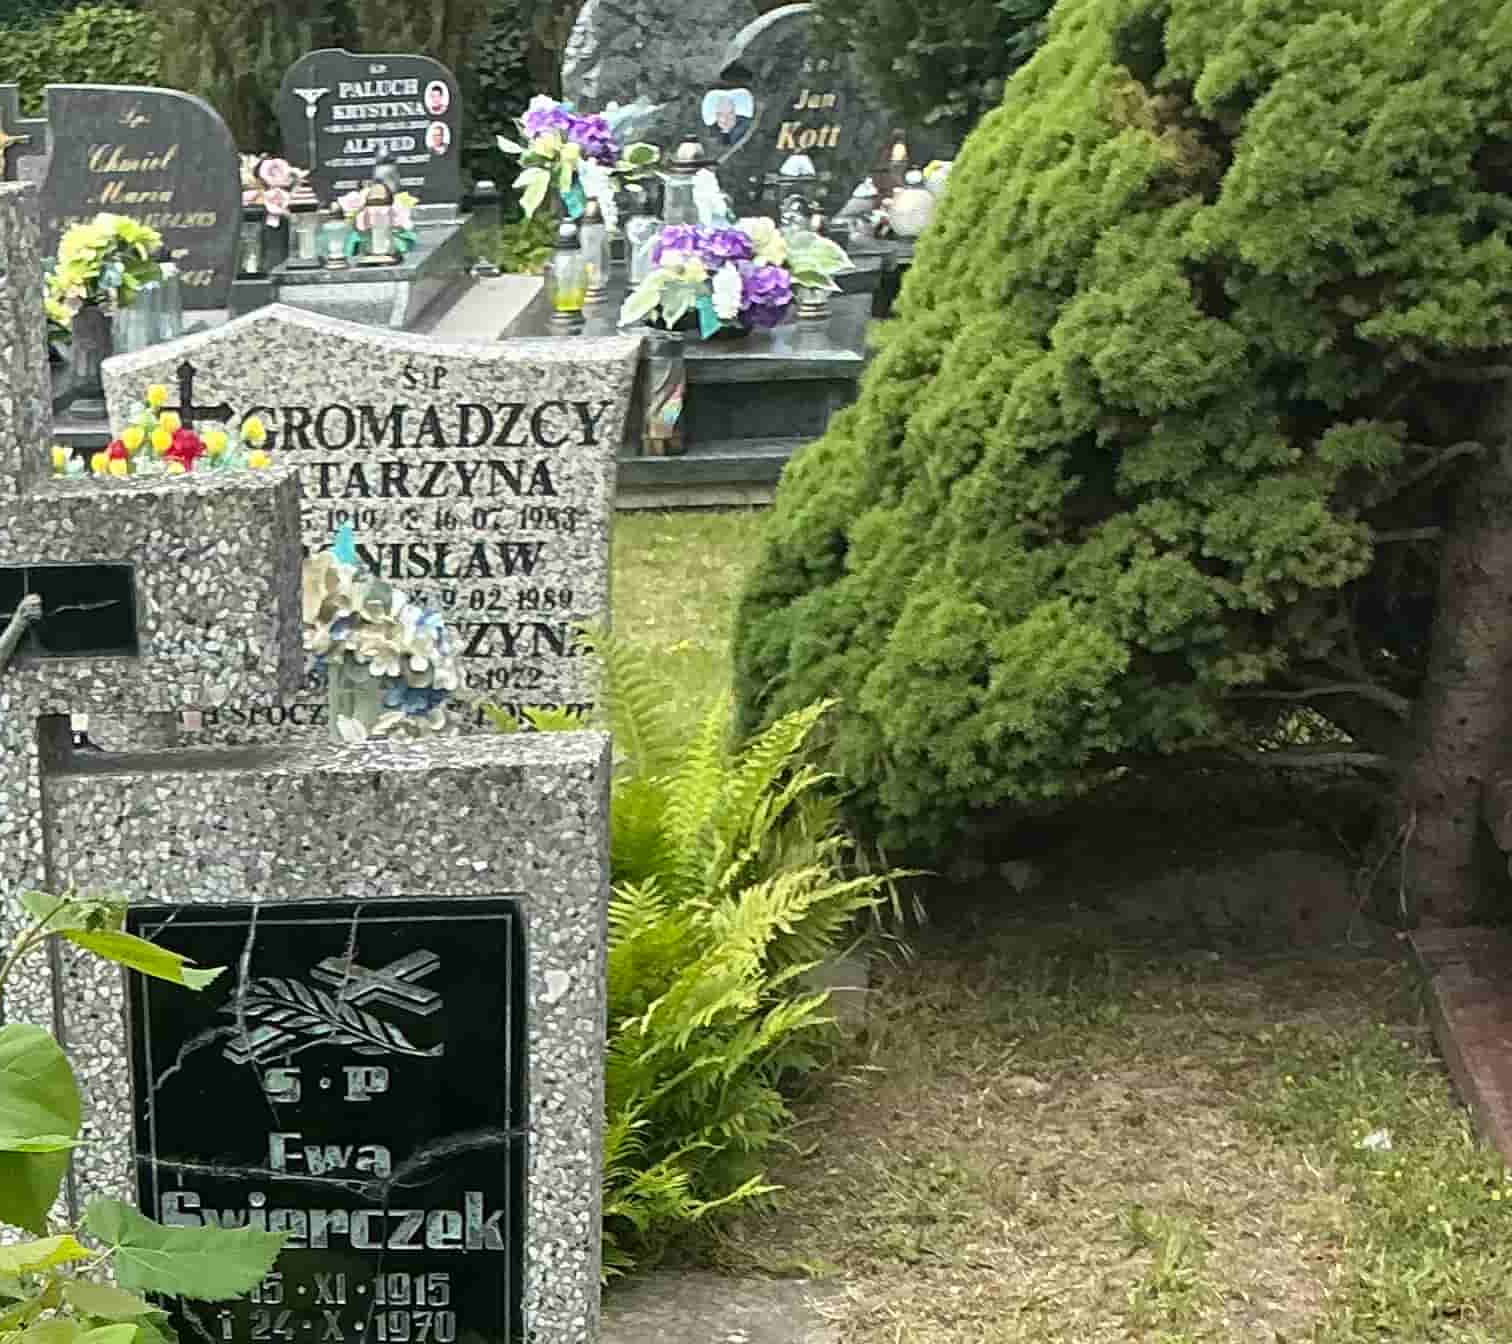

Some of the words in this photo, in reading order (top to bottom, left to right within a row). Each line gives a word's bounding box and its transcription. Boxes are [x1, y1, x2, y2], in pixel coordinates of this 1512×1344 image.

[338, 78, 419, 99] PALUCH
[792, 89, 838, 111] Jan
[331, 101, 427, 120] KRYSTYNA
[775, 120, 842, 151] Kott
[88, 143, 180, 173] Chmiel
[85, 180, 177, 205] Maria
[240, 399, 615, 450] GROMADZCY
[295, 458, 559, 499] TARZYNA
[352, 540, 546, 579] NISŁAW
[268, 1132, 391, 1179] Ewa
